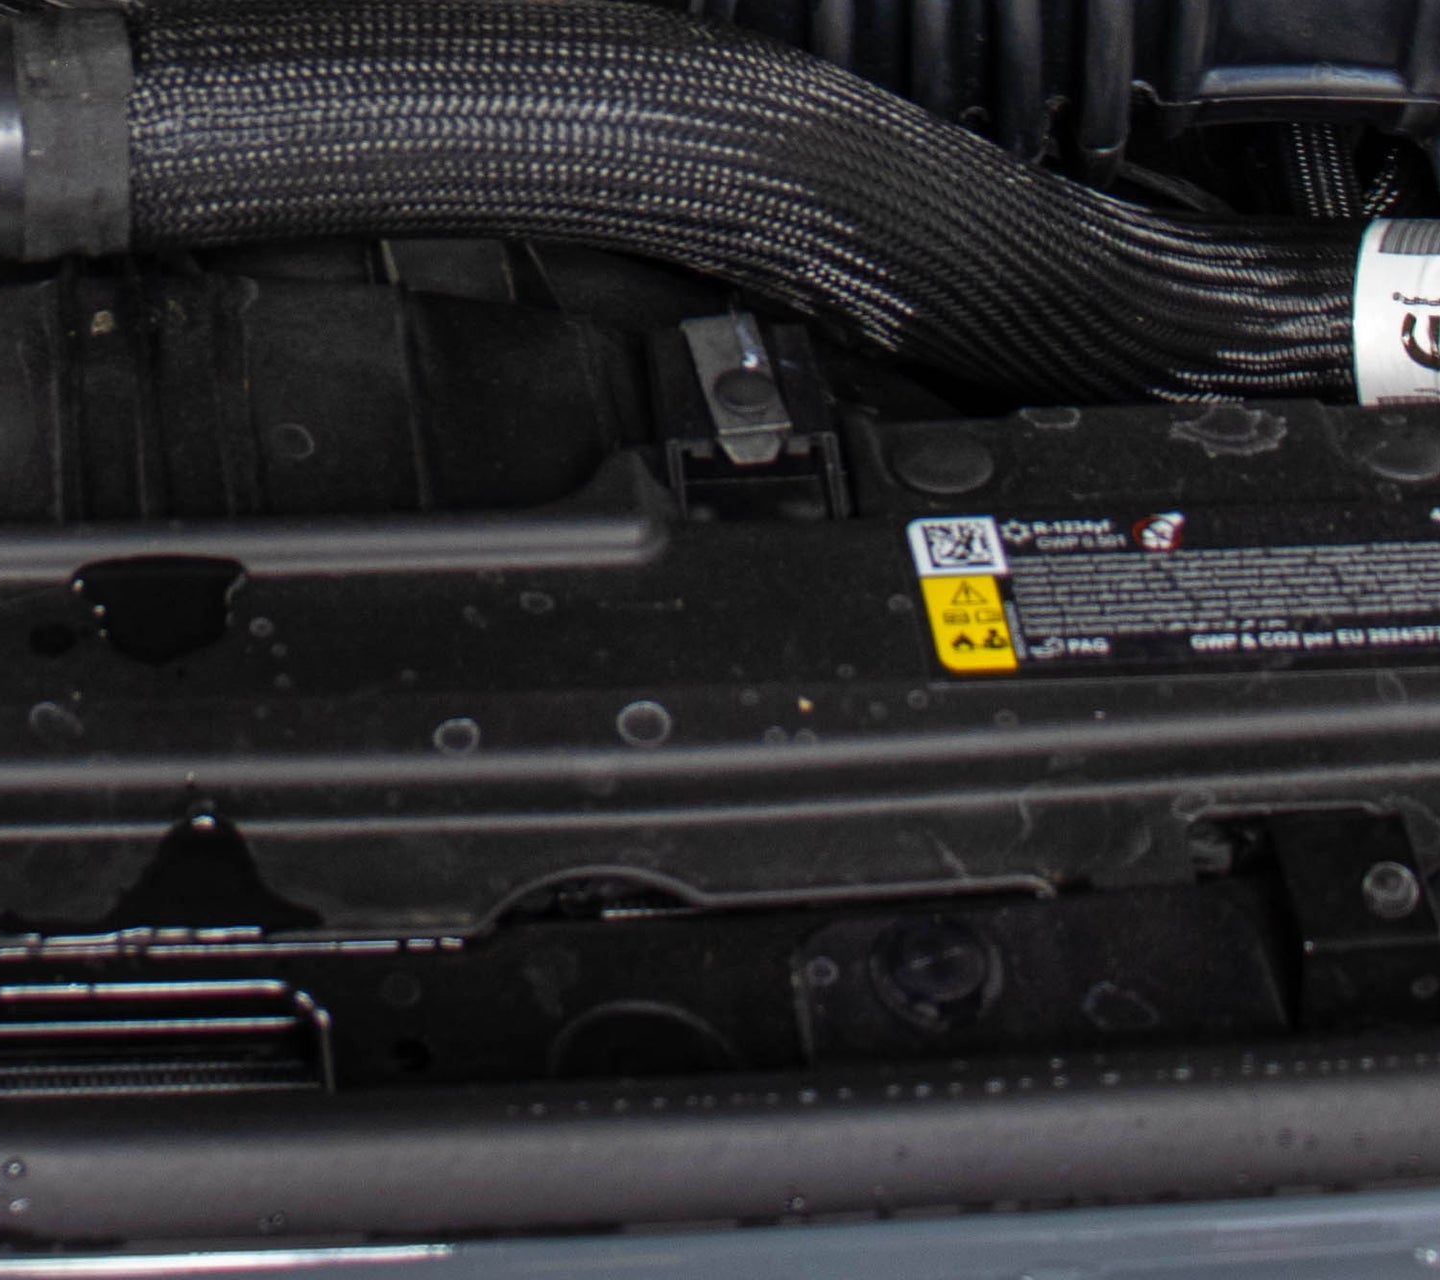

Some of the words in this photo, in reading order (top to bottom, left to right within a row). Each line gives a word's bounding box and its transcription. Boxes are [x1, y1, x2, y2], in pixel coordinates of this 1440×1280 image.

[1067, 637, 1111, 655] PAG
[1189, 632, 1239, 652] GWP
[1240, 631, 1257, 650] &
[1258, 630, 1300, 649] CO2
[1336, 627, 1365, 645] EU
